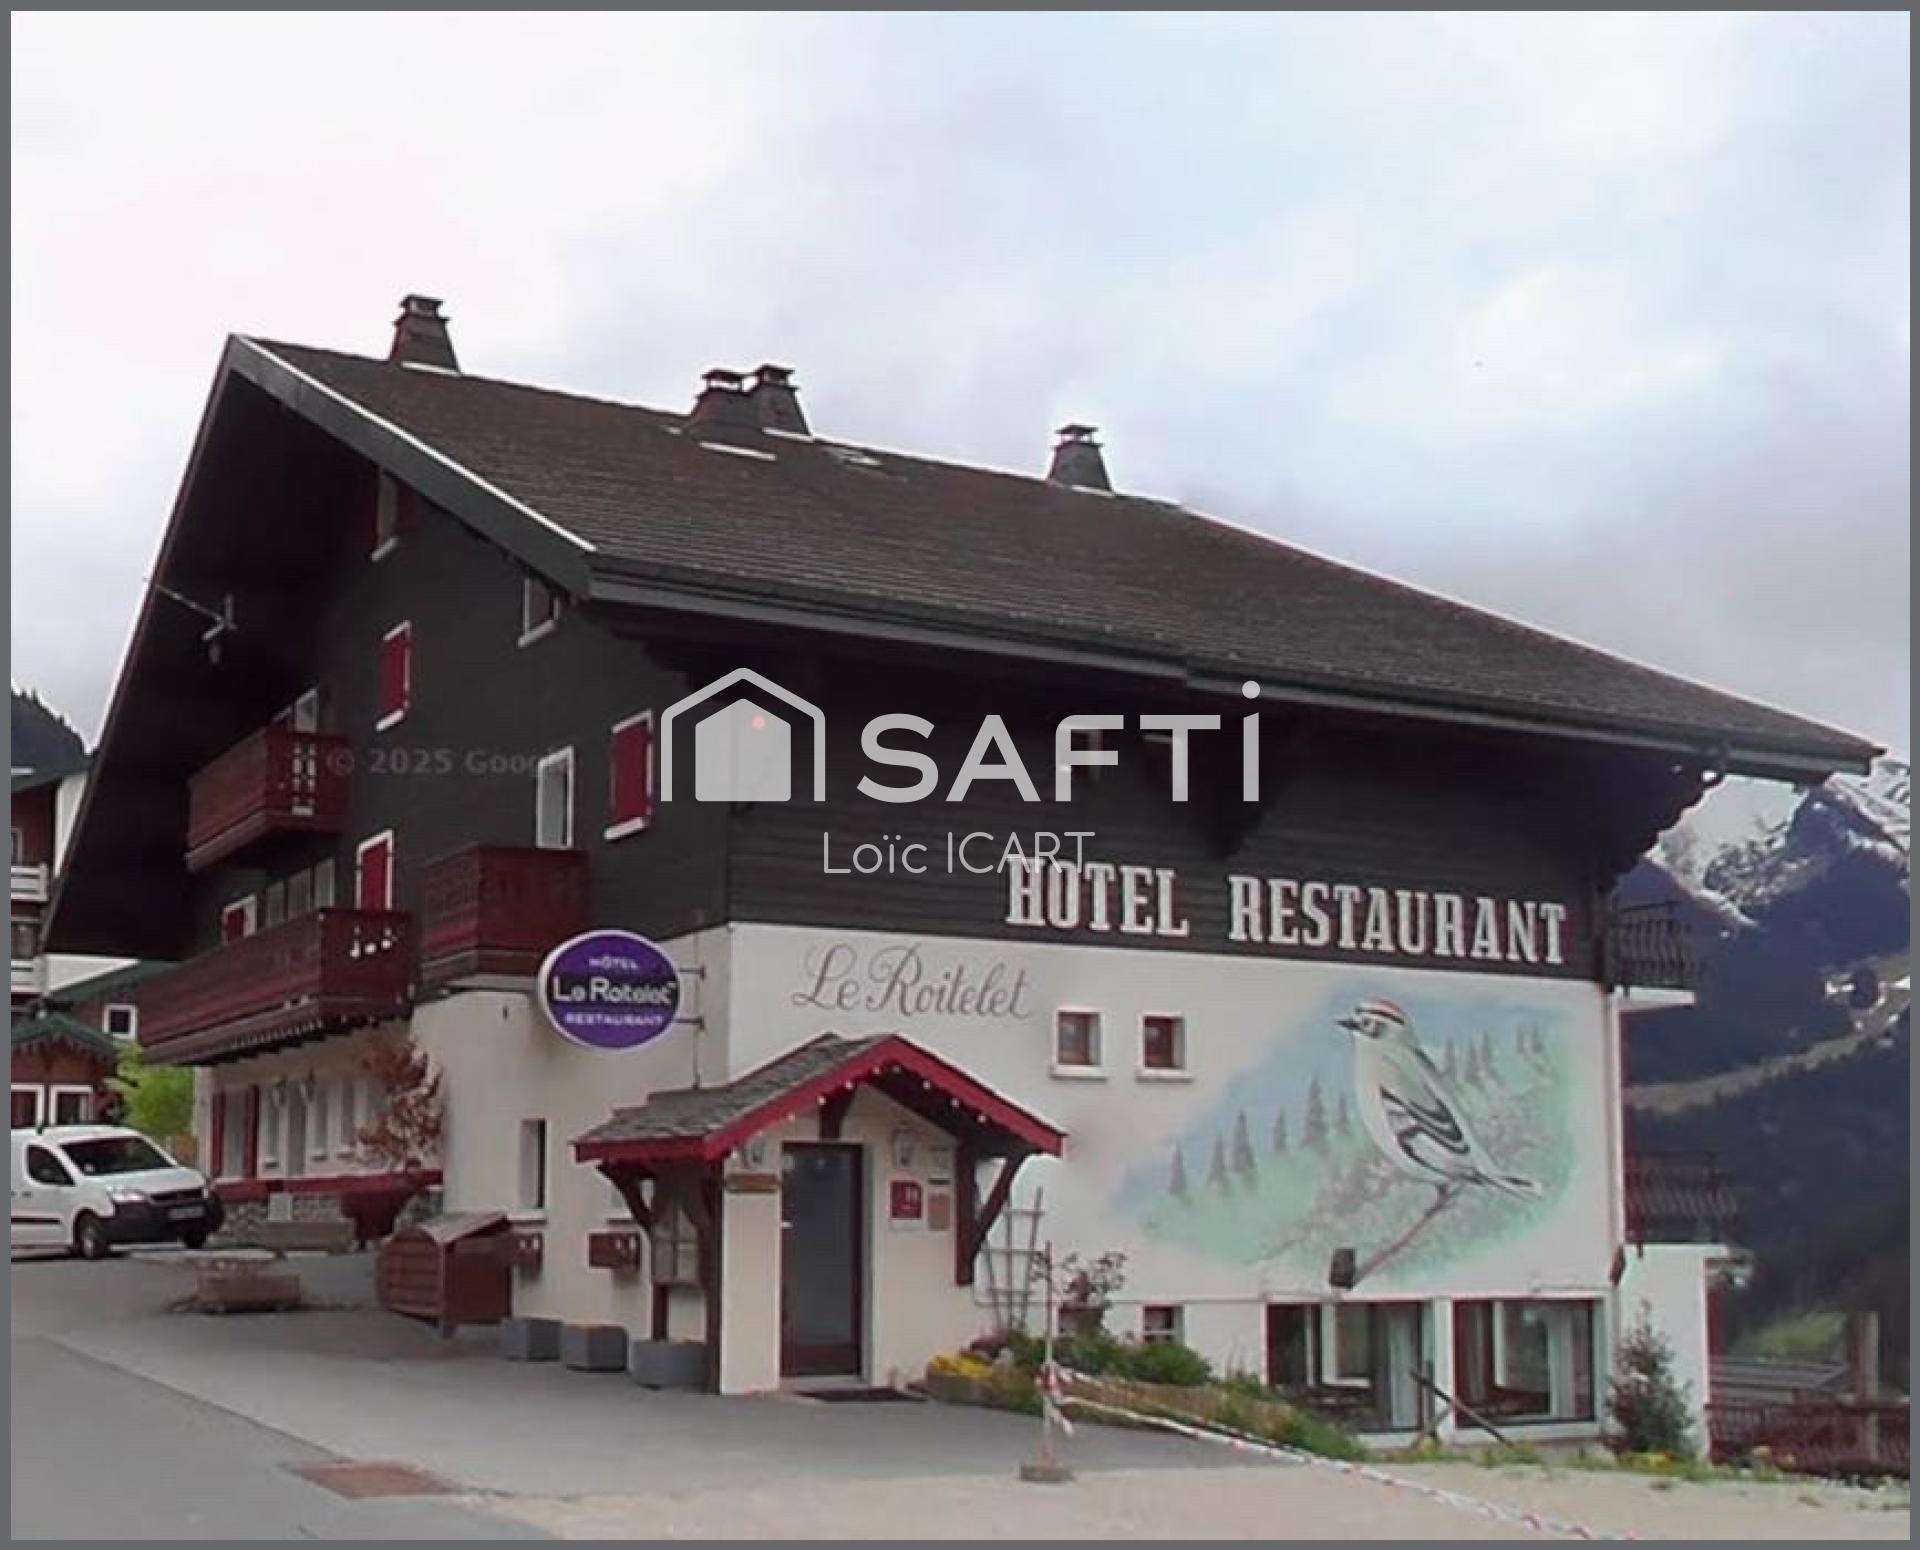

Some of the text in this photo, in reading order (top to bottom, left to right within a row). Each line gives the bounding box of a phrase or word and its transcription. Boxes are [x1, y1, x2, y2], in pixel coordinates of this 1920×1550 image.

[1005, 857, 1566, 965] HOTEL RESTAURANT
[565, 1012, 664, 1026] RESTAURANT
[790, 942, 1030, 1019] Le Roitelet
